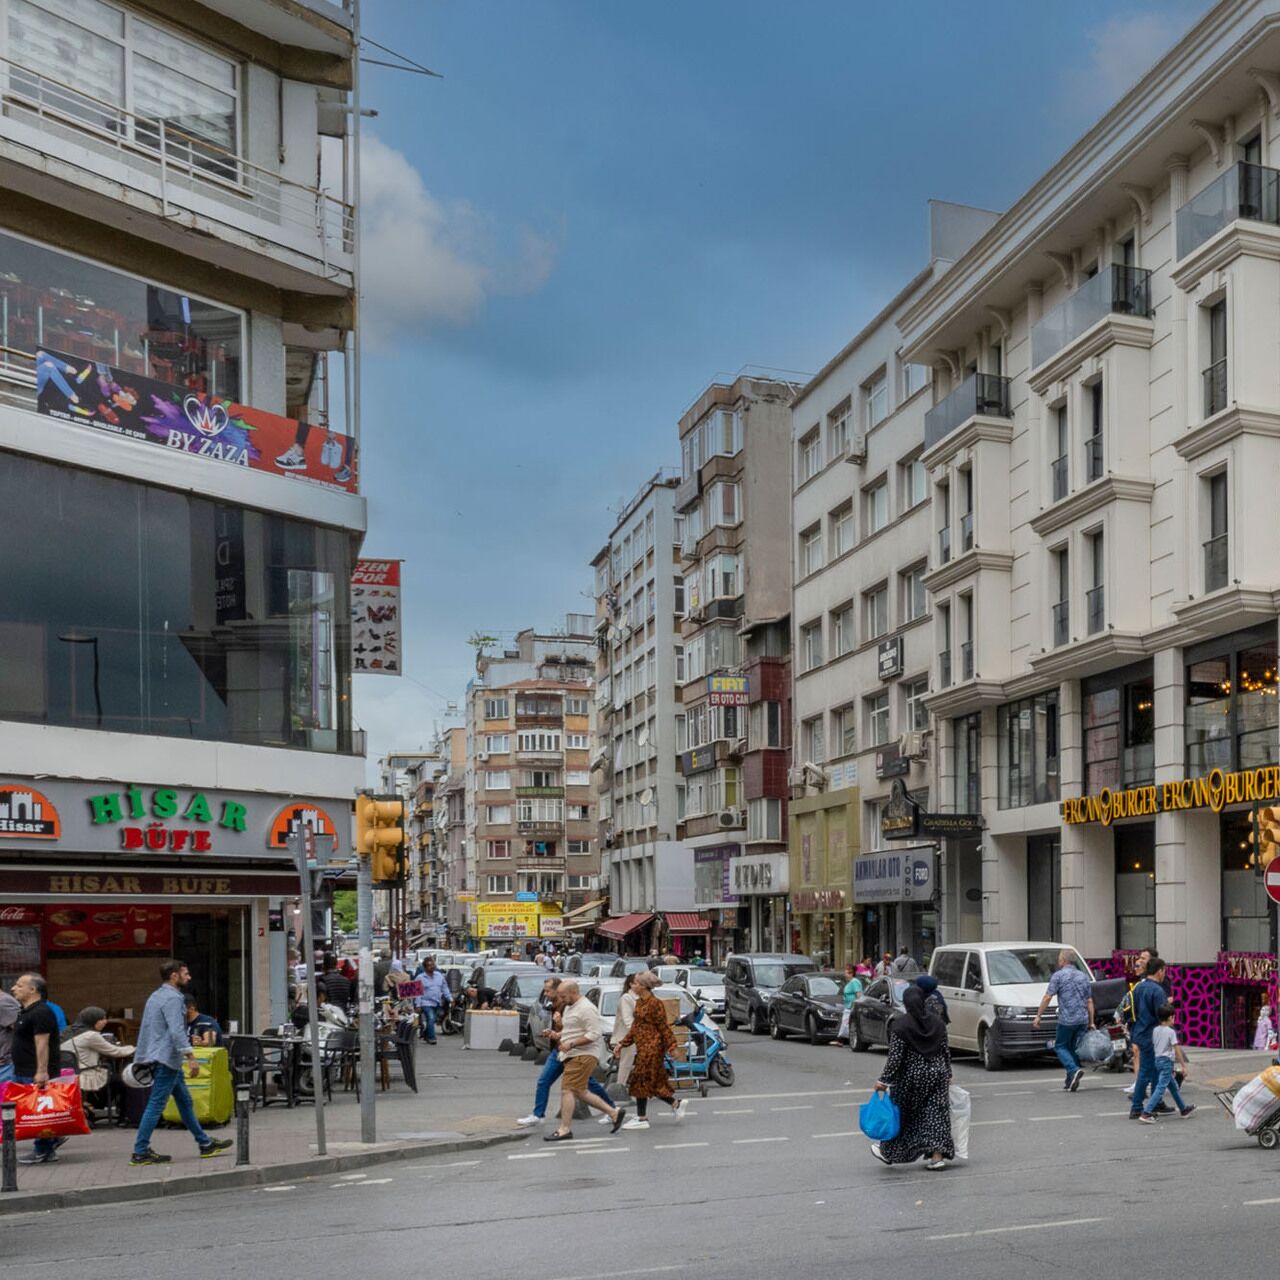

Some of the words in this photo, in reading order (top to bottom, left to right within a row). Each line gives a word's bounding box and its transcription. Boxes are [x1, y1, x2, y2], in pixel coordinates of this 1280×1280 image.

[167, 429, 196, 452] BY
[199, 439, 249, 467] ZAZA
[357, 562, 390, 572] ZEN
[351, 572, 387, 583] POR
[712, 677, 746, 690] FIAT
[721, 694, 735, 704] OTO
[1065, 795, 1100, 825] ERCAN
[1112, 786, 1158, 818] BURGER
[1163, 777, 1210, 810] ERCAN
[1225, 766, 1280, 803] BURGER
[90, 784, 248, 832] HİSAR
[121, 822, 212, 852] BÜFE
[915, 867, 928, 881] FORD
[49, 875, 142, 893] HİSAR
[162, 877, 232, 894] BÜFE
